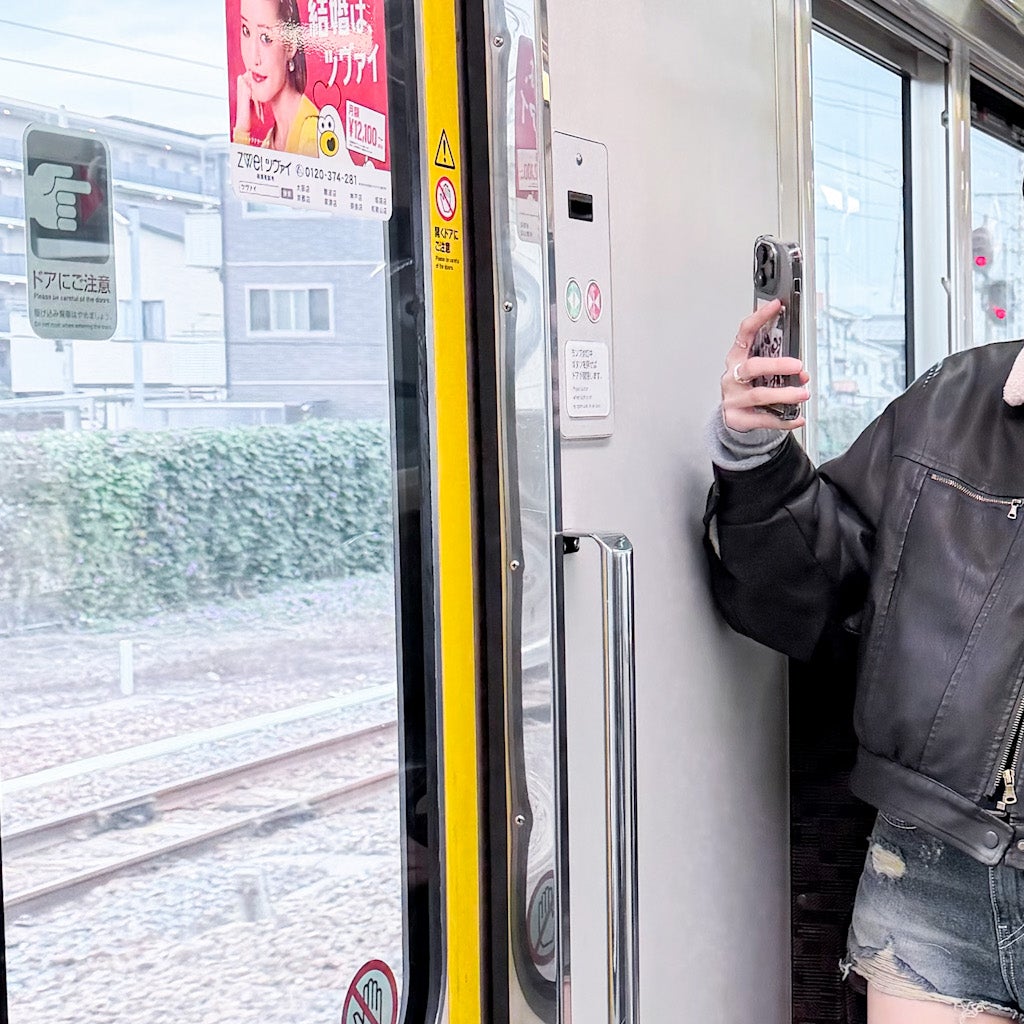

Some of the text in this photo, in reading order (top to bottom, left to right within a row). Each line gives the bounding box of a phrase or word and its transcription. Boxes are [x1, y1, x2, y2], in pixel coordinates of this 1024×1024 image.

[304, 166, 358, 186] 0120-374-281
[33, 270, 111, 294] ドアにご注意
